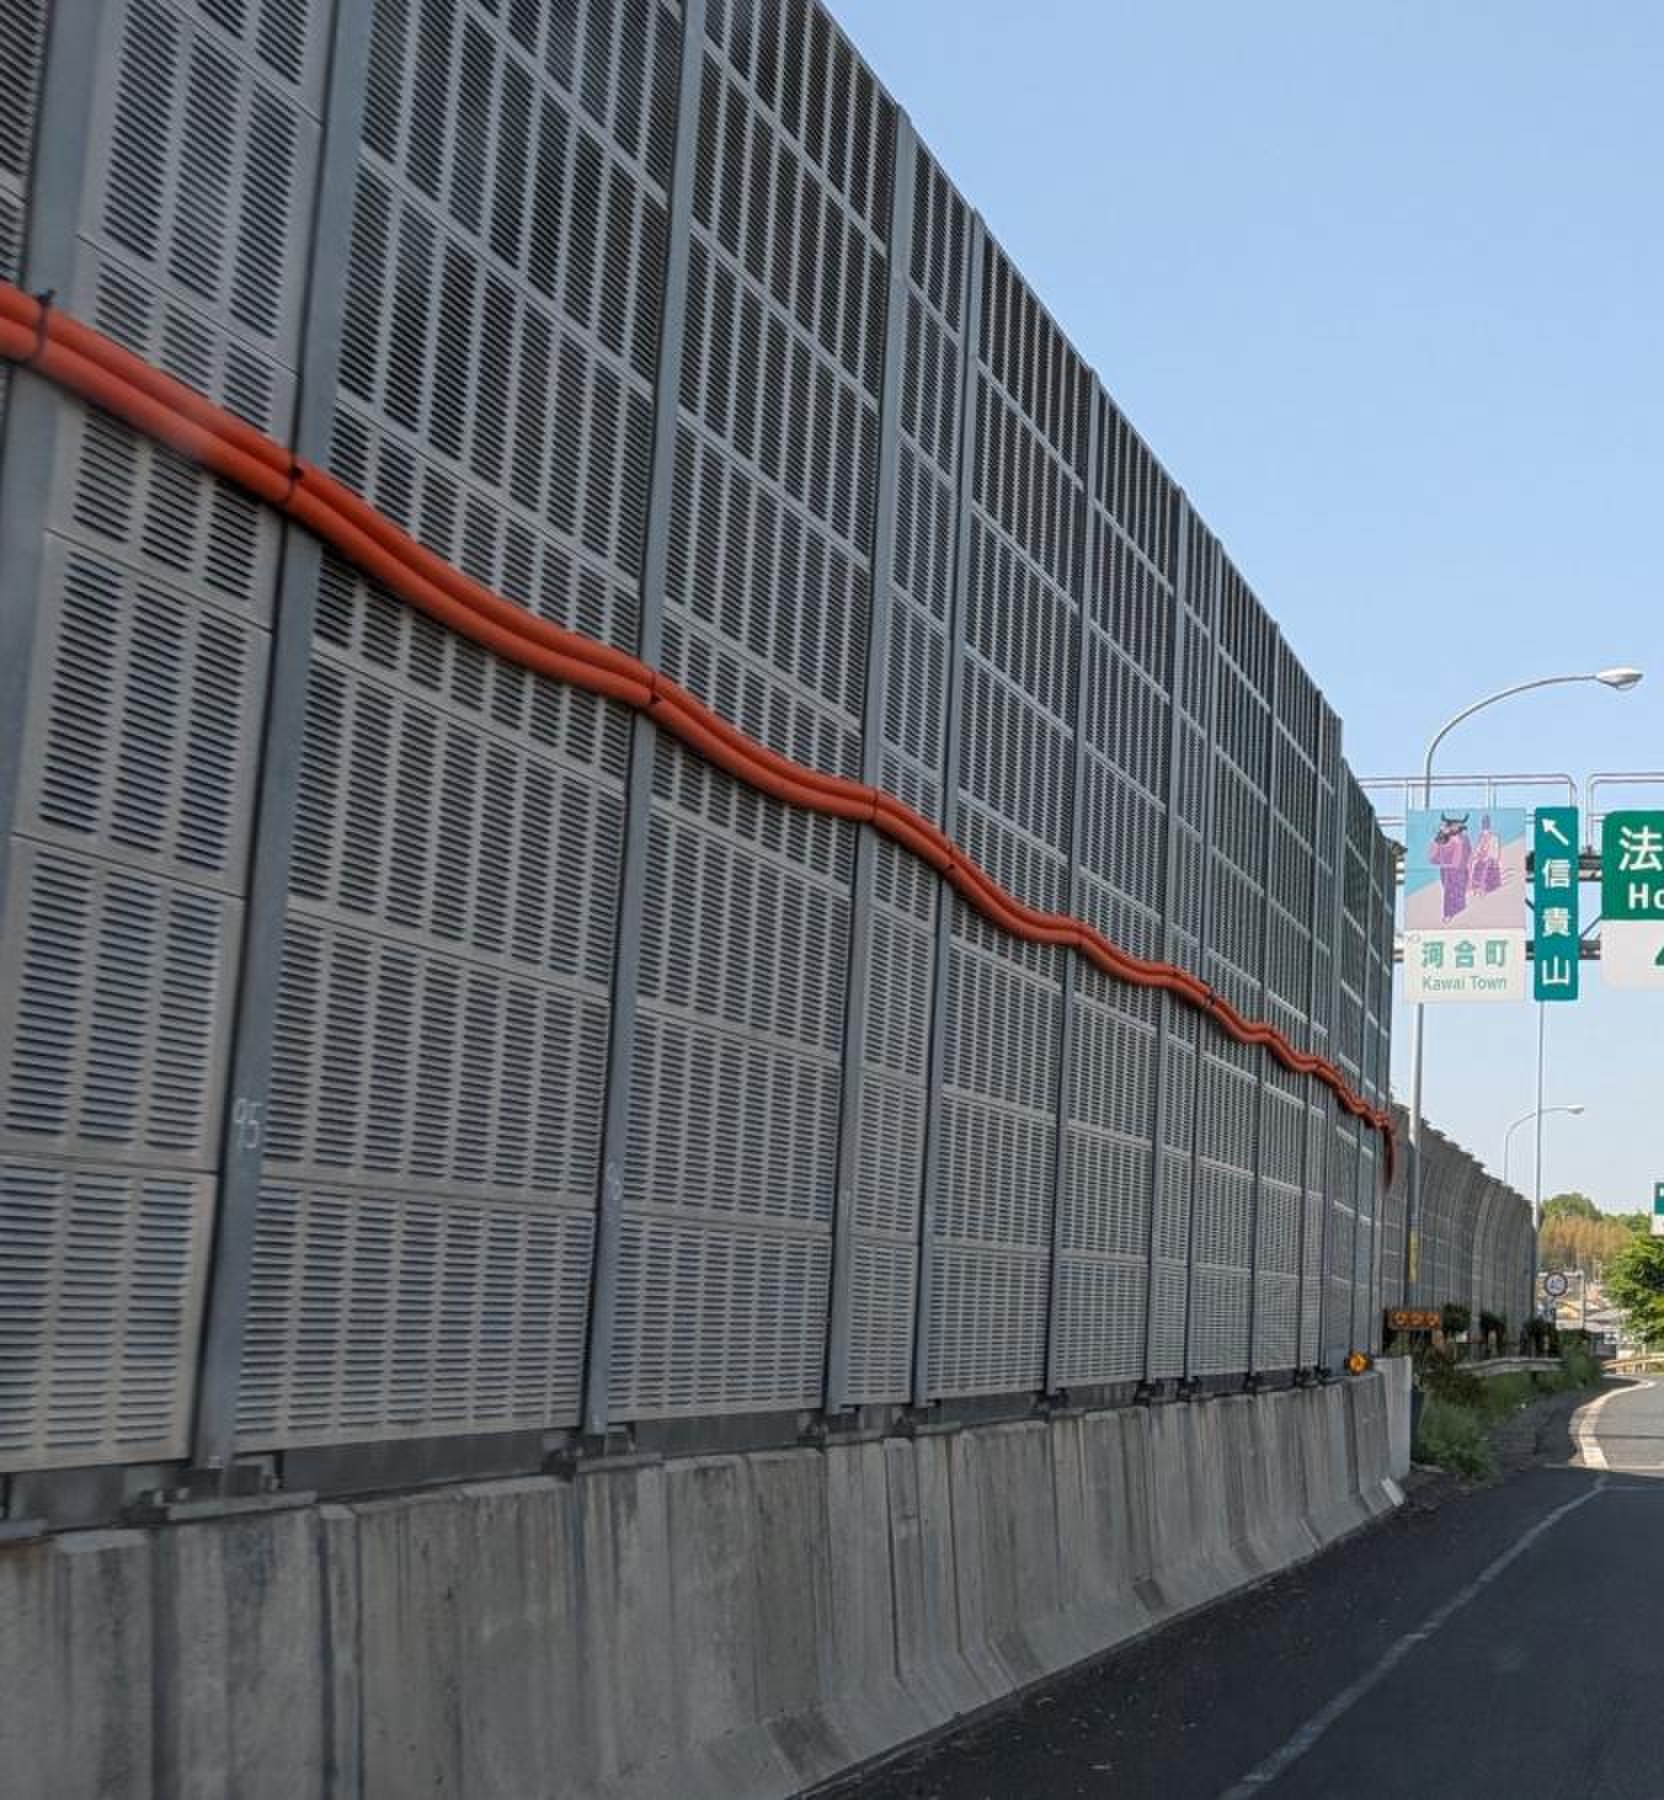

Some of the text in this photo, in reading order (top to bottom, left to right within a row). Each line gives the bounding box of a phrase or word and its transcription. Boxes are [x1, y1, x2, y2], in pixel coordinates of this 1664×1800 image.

[1542, 858, 1571, 986] 信貴山
[1421, 939, 1508, 969] 河合町
[1422, 976, 1507, 991] Kawai Town
